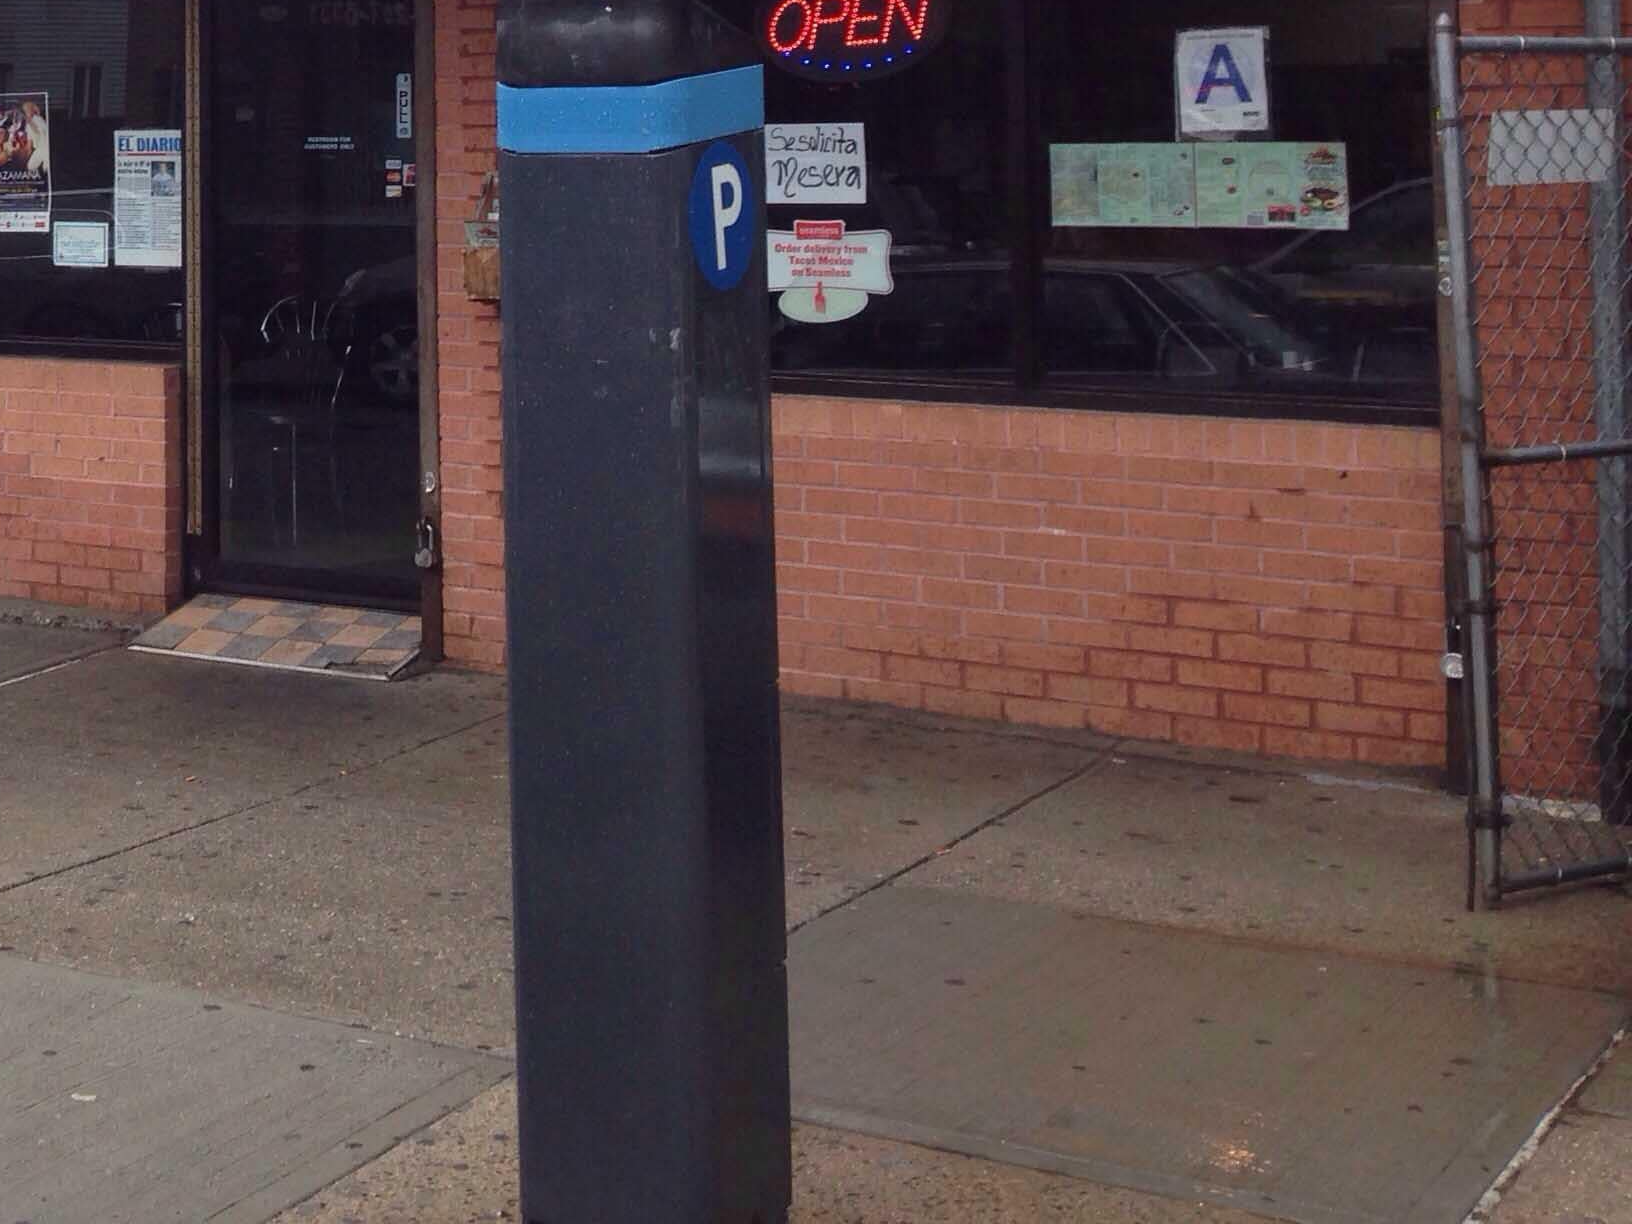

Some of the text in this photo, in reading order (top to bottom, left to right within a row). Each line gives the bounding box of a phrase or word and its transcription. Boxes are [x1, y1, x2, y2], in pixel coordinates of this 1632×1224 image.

[1194, 43, 1253, 104] A
[399, 90, 409, 124] PULL
[118, 136, 182, 153] EL DIARIO
[771, 156, 862, 198] Mesera
[711, 162, 743, 271] P
[774, 243, 868, 255] Order delivery from
[789, 255, 855, 266] Tacos Mexico
[804, 267, 851, 277] Seamless
